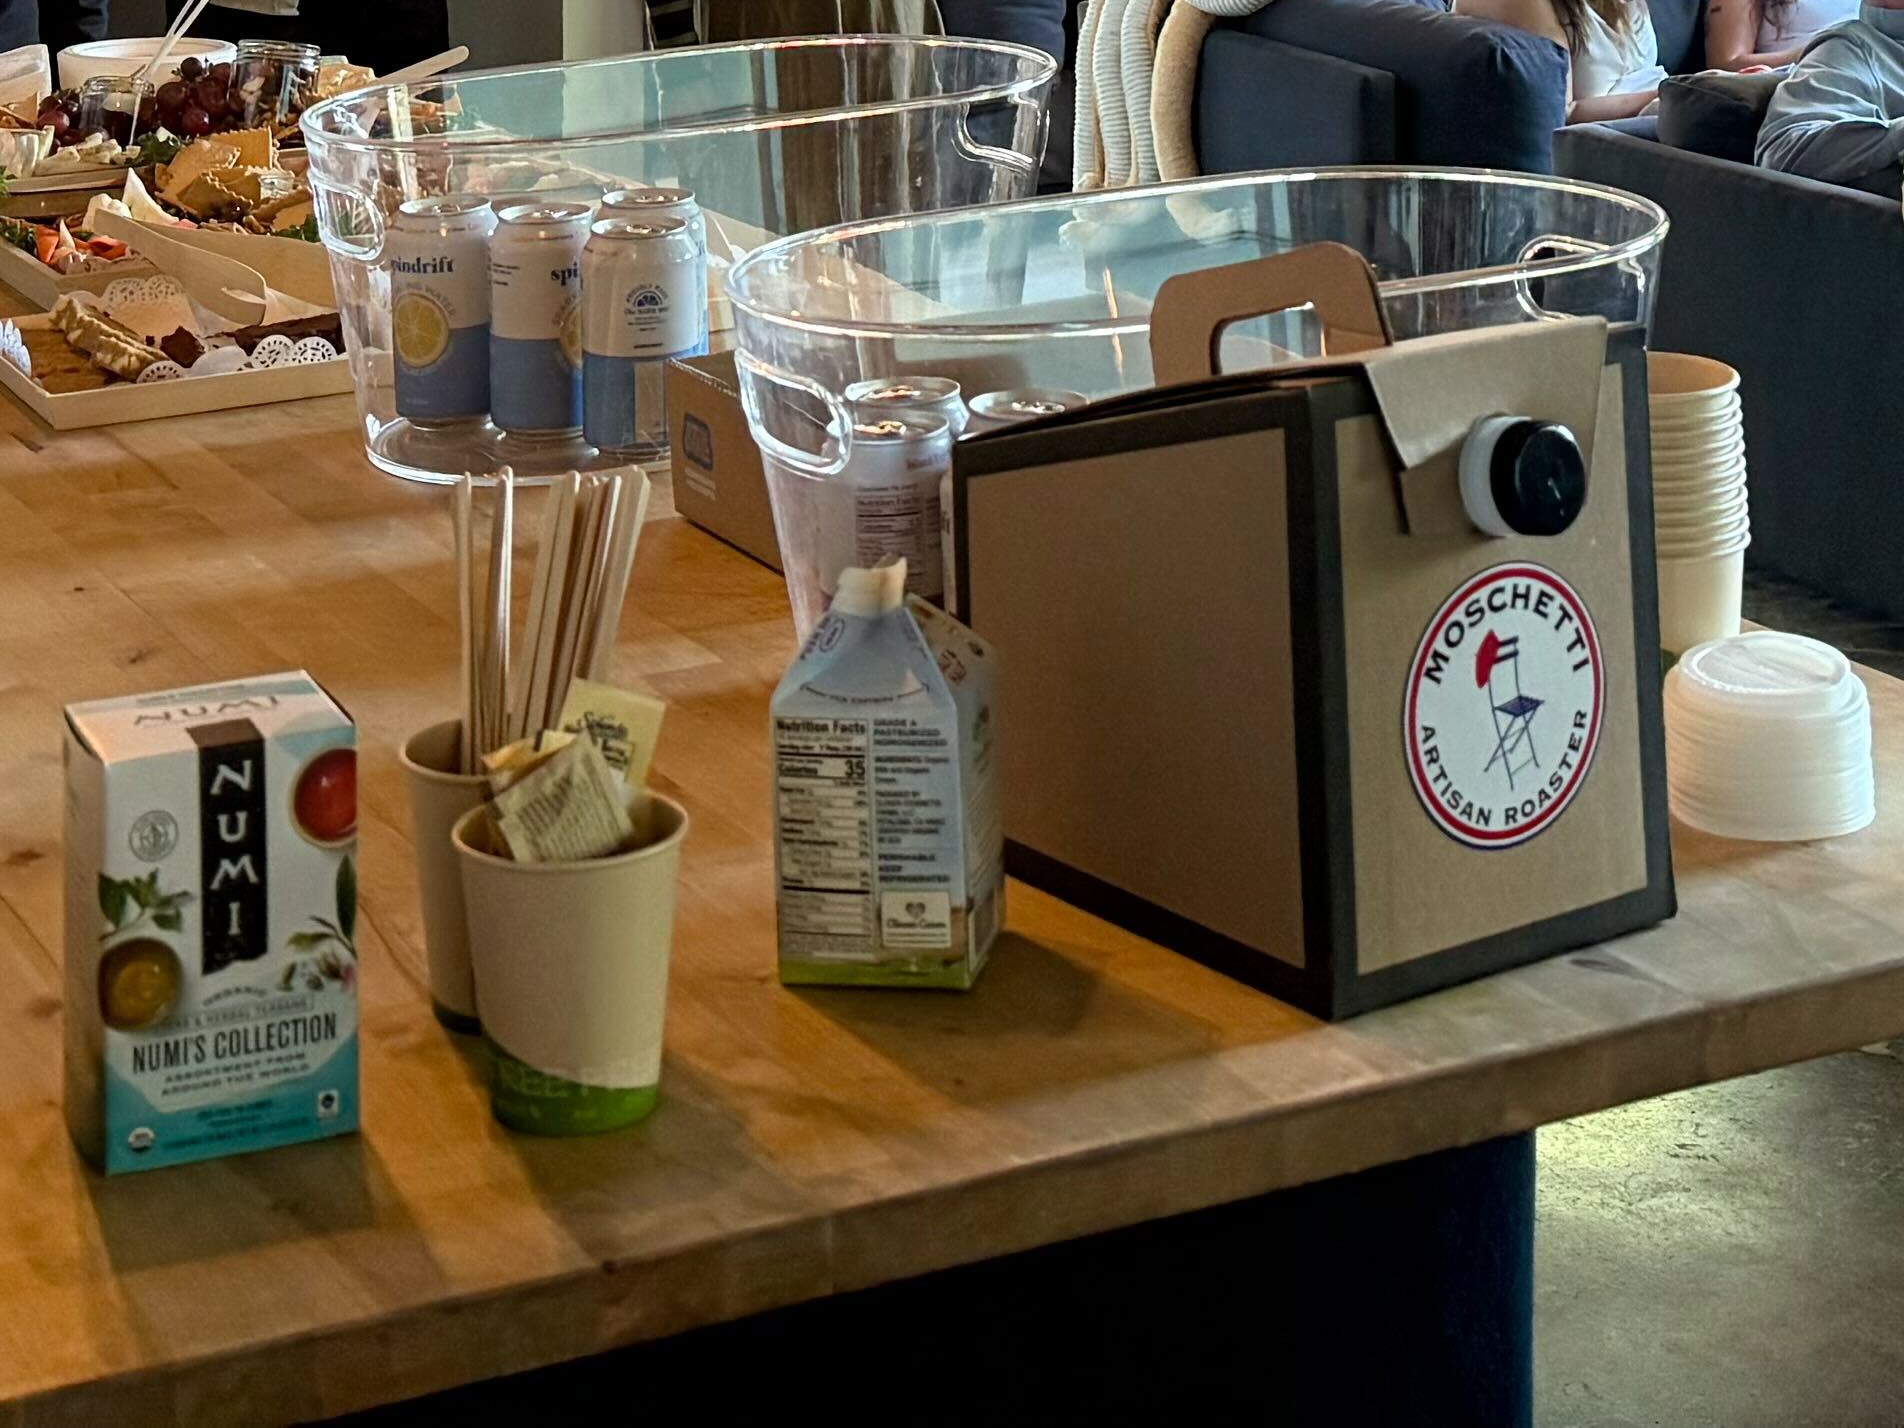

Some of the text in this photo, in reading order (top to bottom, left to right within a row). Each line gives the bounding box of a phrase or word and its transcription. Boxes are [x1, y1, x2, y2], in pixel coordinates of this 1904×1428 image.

[1423, 583, 1590, 685] MOSCHETTI
[134, 695, 279, 726] NUMI
[776, 720, 866, 735] Nutrition Facts
[845, 759, 866, 778] 35
[1421, 709, 1588, 827] ARTISAN ROASTER
[209, 759, 260, 936] NUMI
[132, 1012, 337, 1074] NUMI'S COLLECTION
[165, 1052, 306, 1084] ASSORTMENT FROM
